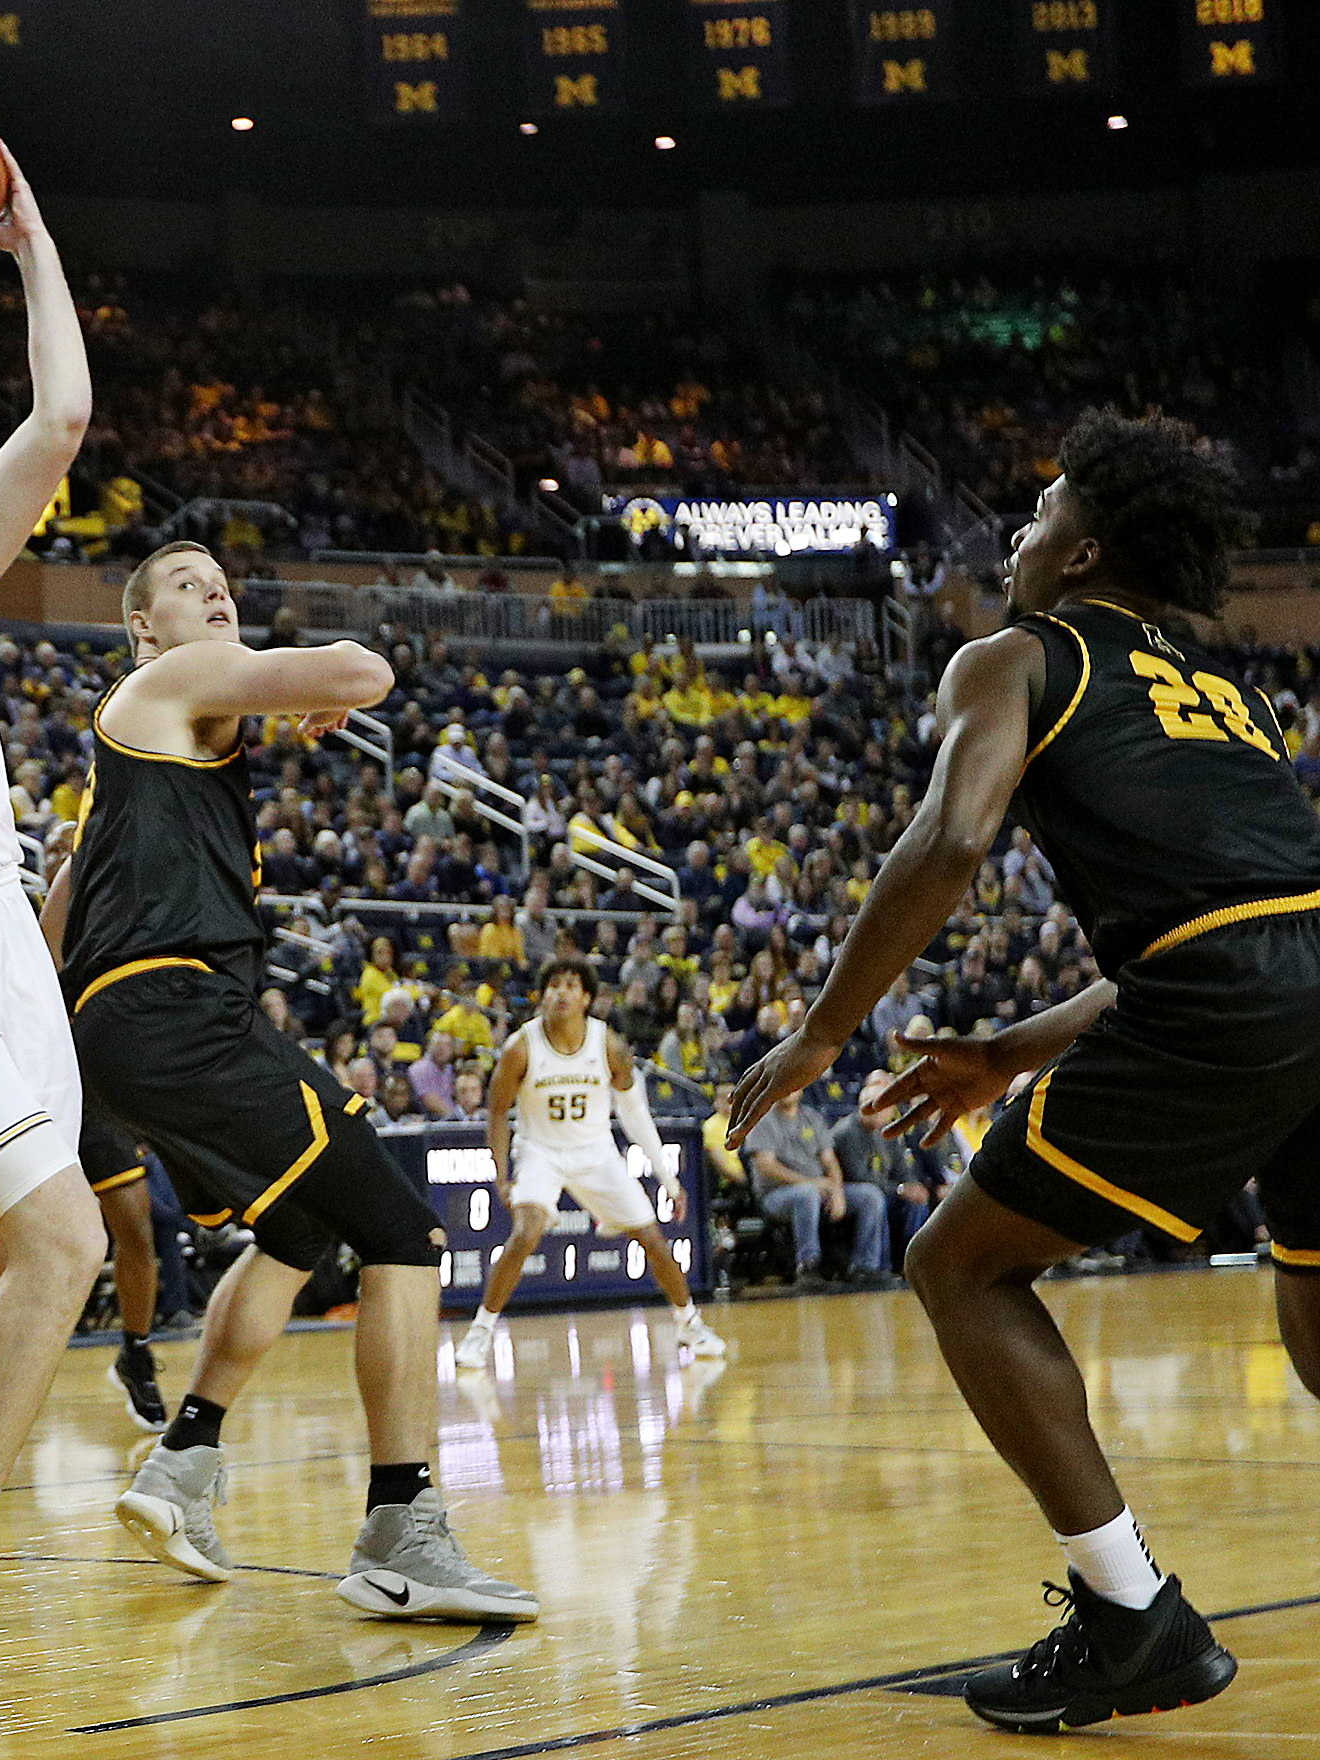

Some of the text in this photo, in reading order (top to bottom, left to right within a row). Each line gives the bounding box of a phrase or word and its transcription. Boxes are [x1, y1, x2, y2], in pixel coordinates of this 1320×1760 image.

[883, 57, 927, 94] M
[1046, 48, 1090, 84] M
[1209, 38, 1257, 77] M
[394, 80, 439, 113] M
[554, 72, 599, 108] M
[716, 64, 762, 100] M
[674, 501, 774, 526] ALWAYS
[674, 523, 783, 551] OREVER
[548, 1094, 587, 1121] 55
